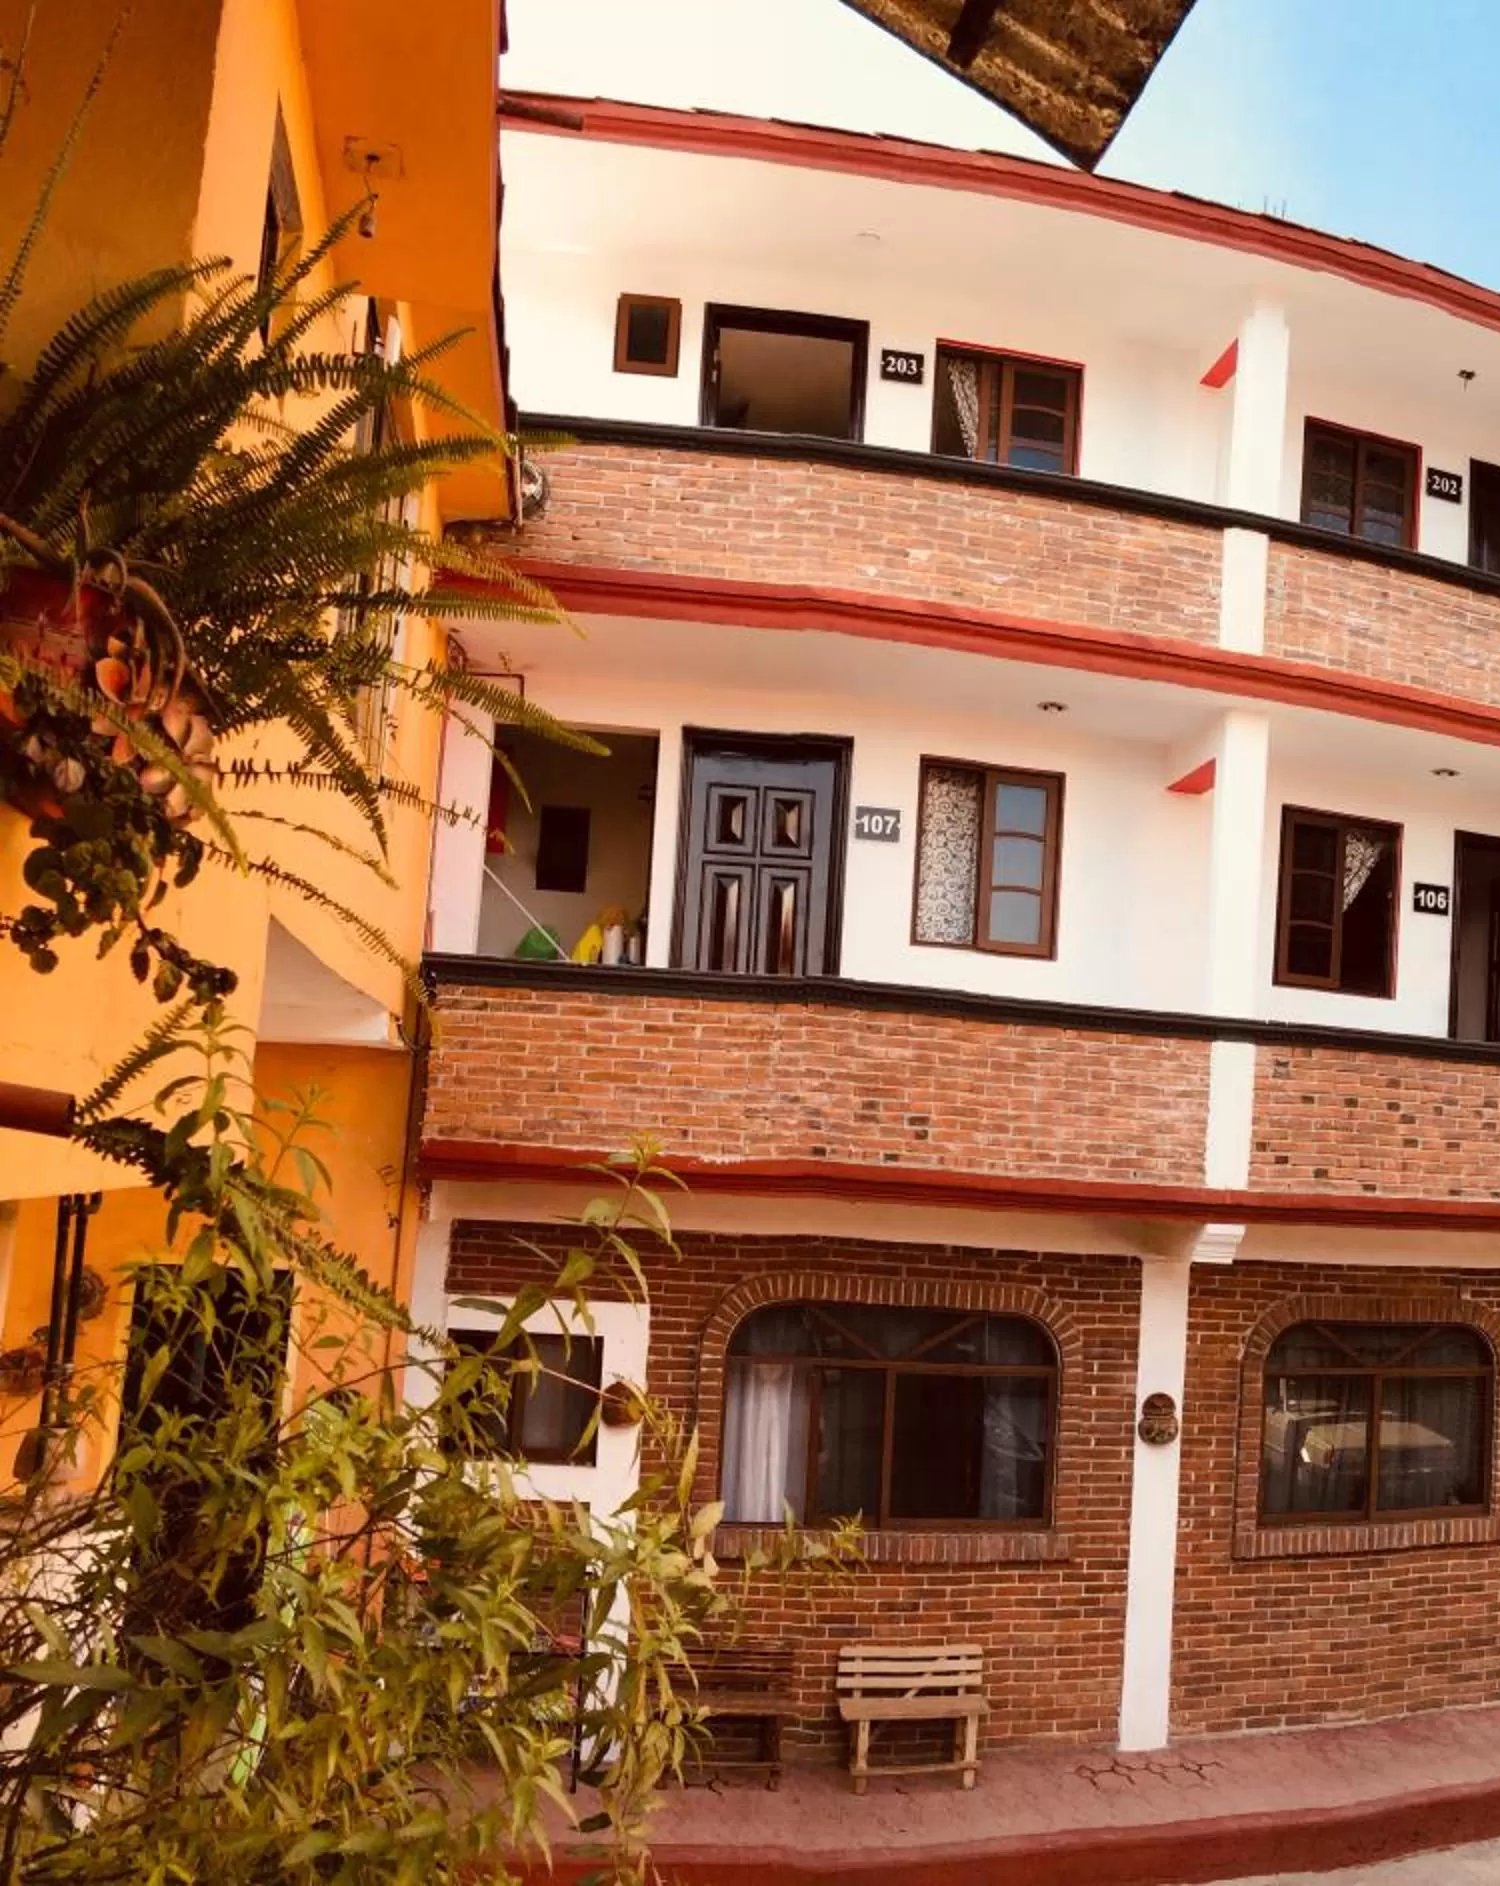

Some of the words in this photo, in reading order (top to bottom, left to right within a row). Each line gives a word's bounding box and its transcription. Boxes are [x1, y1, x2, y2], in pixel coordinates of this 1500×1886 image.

[886, 357, 918, 376] 203
[1432, 476, 1458, 494] 202
[861, 815, 896, 835] 107
[1418, 890, 1447, 909] 106
